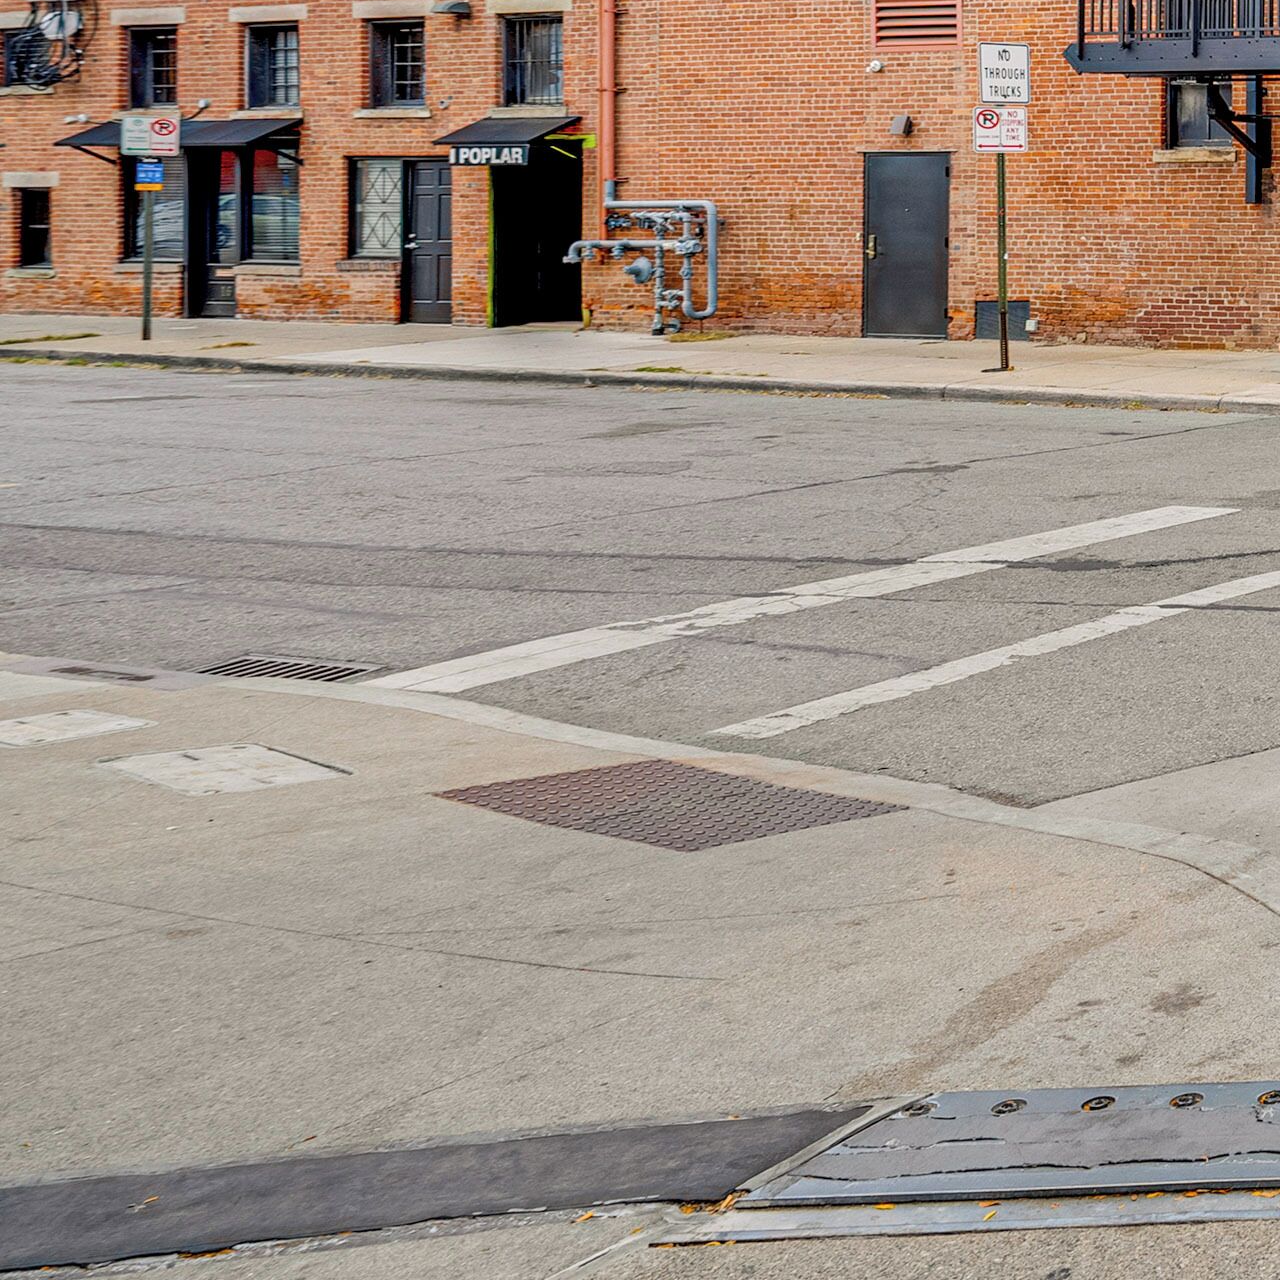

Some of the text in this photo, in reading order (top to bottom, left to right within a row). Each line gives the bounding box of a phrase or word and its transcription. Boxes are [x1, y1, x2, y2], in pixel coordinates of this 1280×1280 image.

[998, 49, 1011, 62] NO
[984, 67, 1026, 80] THROUGH
[989, 85, 1022, 98] TRUCKS
[459, 147, 523, 164] POPLAR
